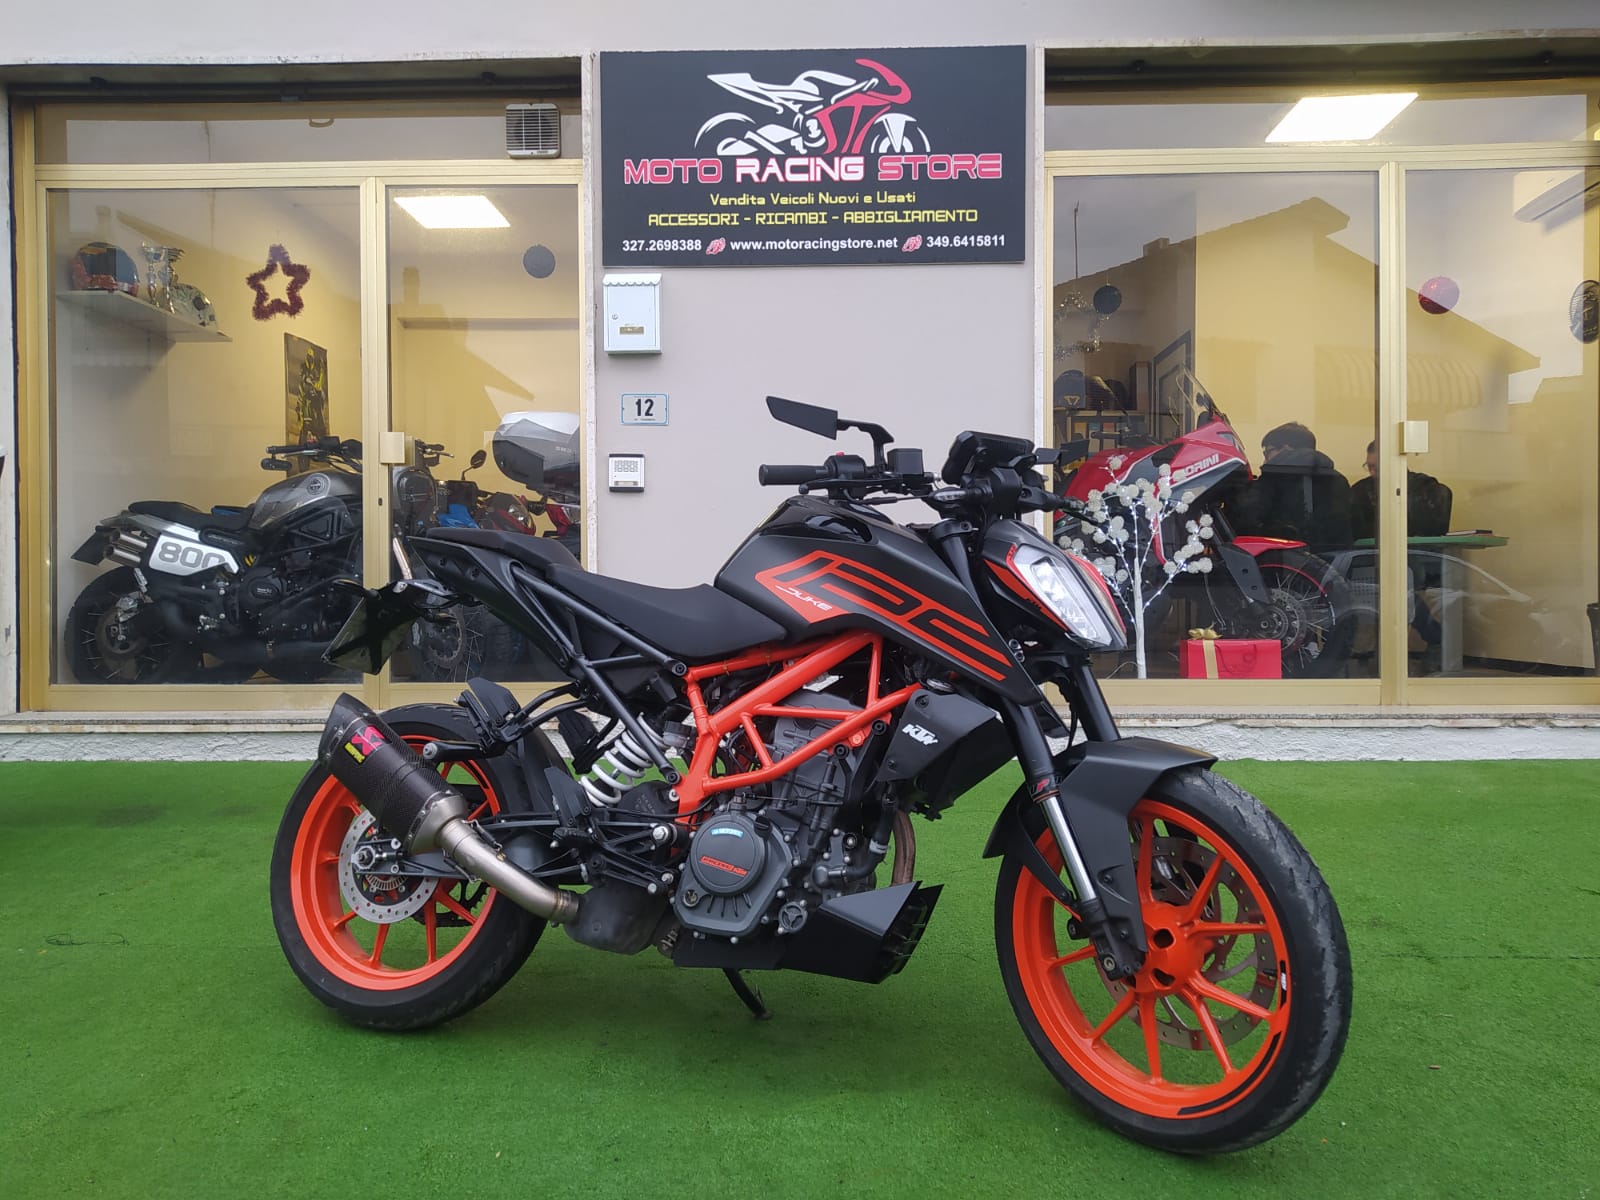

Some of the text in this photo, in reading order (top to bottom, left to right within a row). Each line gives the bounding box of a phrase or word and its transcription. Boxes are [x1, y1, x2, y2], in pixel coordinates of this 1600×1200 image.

[623, 153, 1002, 184] MOTO RACING STORE
[710, 191, 916, 206] Vendita Veicoli Nuovi e Usati
[648, 213, 740, 226] ACCESSORI
[755, 212, 828, 225] RICAMBI
[843, 209, 978, 224] ABBIGLIAMENTO
[622, 234, 1006, 252] 327.2698388 www.motoracingstore.net 349.6415811
[635, 398, 654, 417] 12
[775, 585, 833, 612] DUKE
[902, 723, 938, 745] KTM
